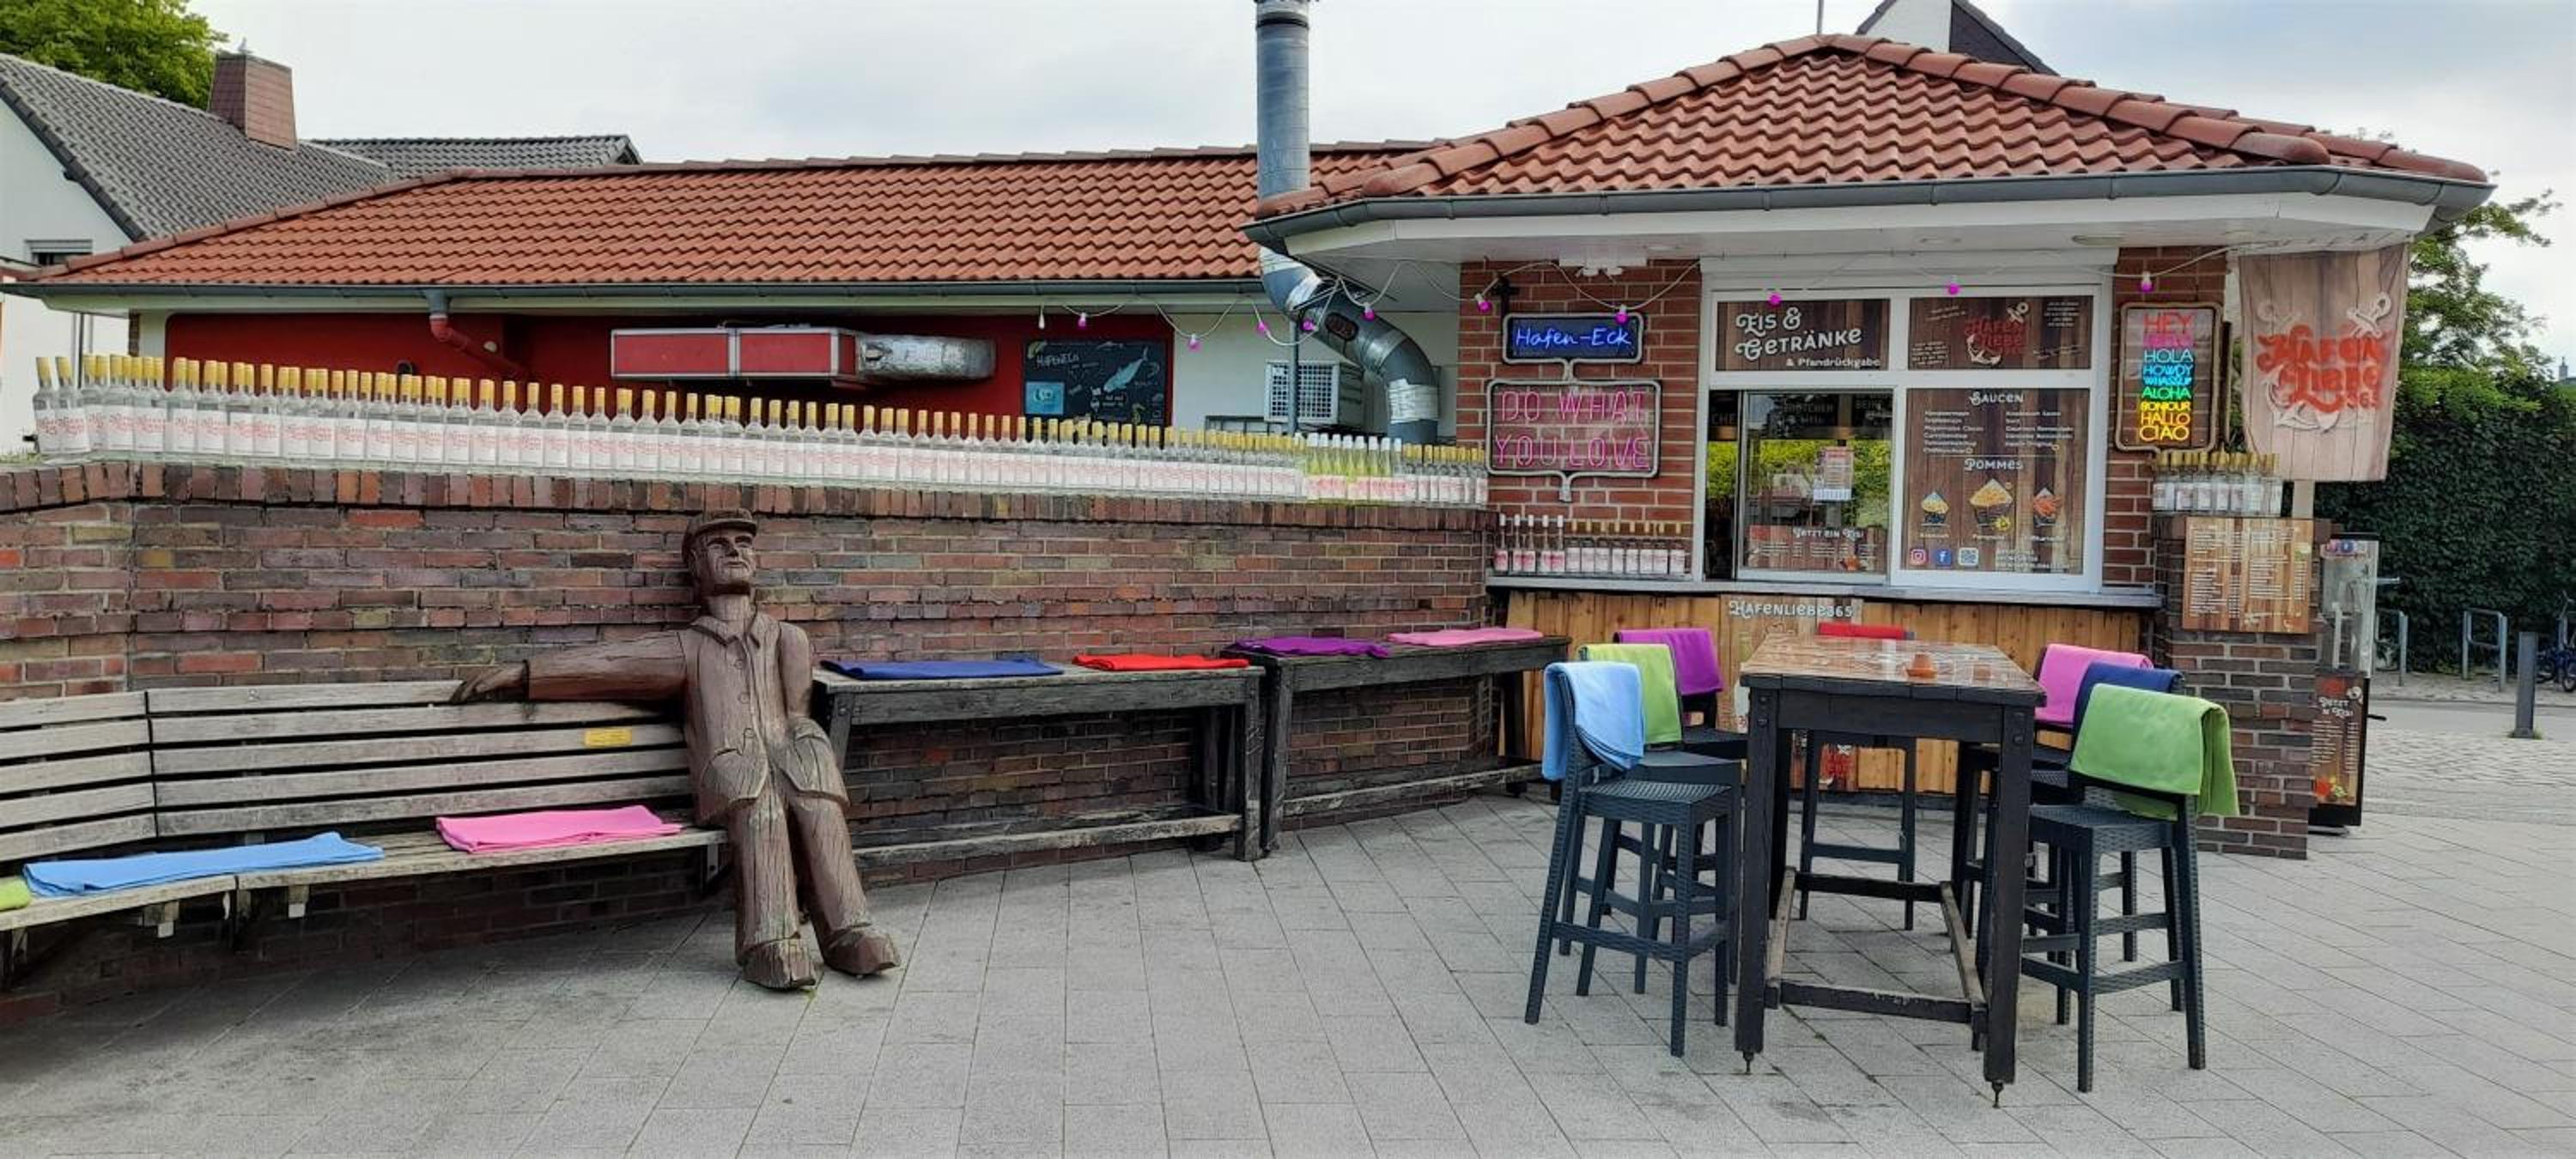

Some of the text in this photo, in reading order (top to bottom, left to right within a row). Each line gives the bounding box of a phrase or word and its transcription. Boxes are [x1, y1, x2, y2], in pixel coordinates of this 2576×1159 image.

[1783, 306, 1802, 331] &
[2143, 313, 2193, 334] HEY
[1516, 327, 1632, 349] Hafen-Eck
[1798, 357, 1880, 369] Pfandrückgabe
[2143, 349, 2194, 363] HOLA
[2143, 365, 2193, 376] HOWDY
[2142, 386, 2192, 399] ALOHA
[1504, 388, 1648, 422] DO WHAT
[2140, 401, 2191, 412] BONJOUR
[2141, 412, 2190, 425] HALLO
[2139, 426, 2190, 441] CIAO
[1495, 434, 1649, 468] YOU LOVE
